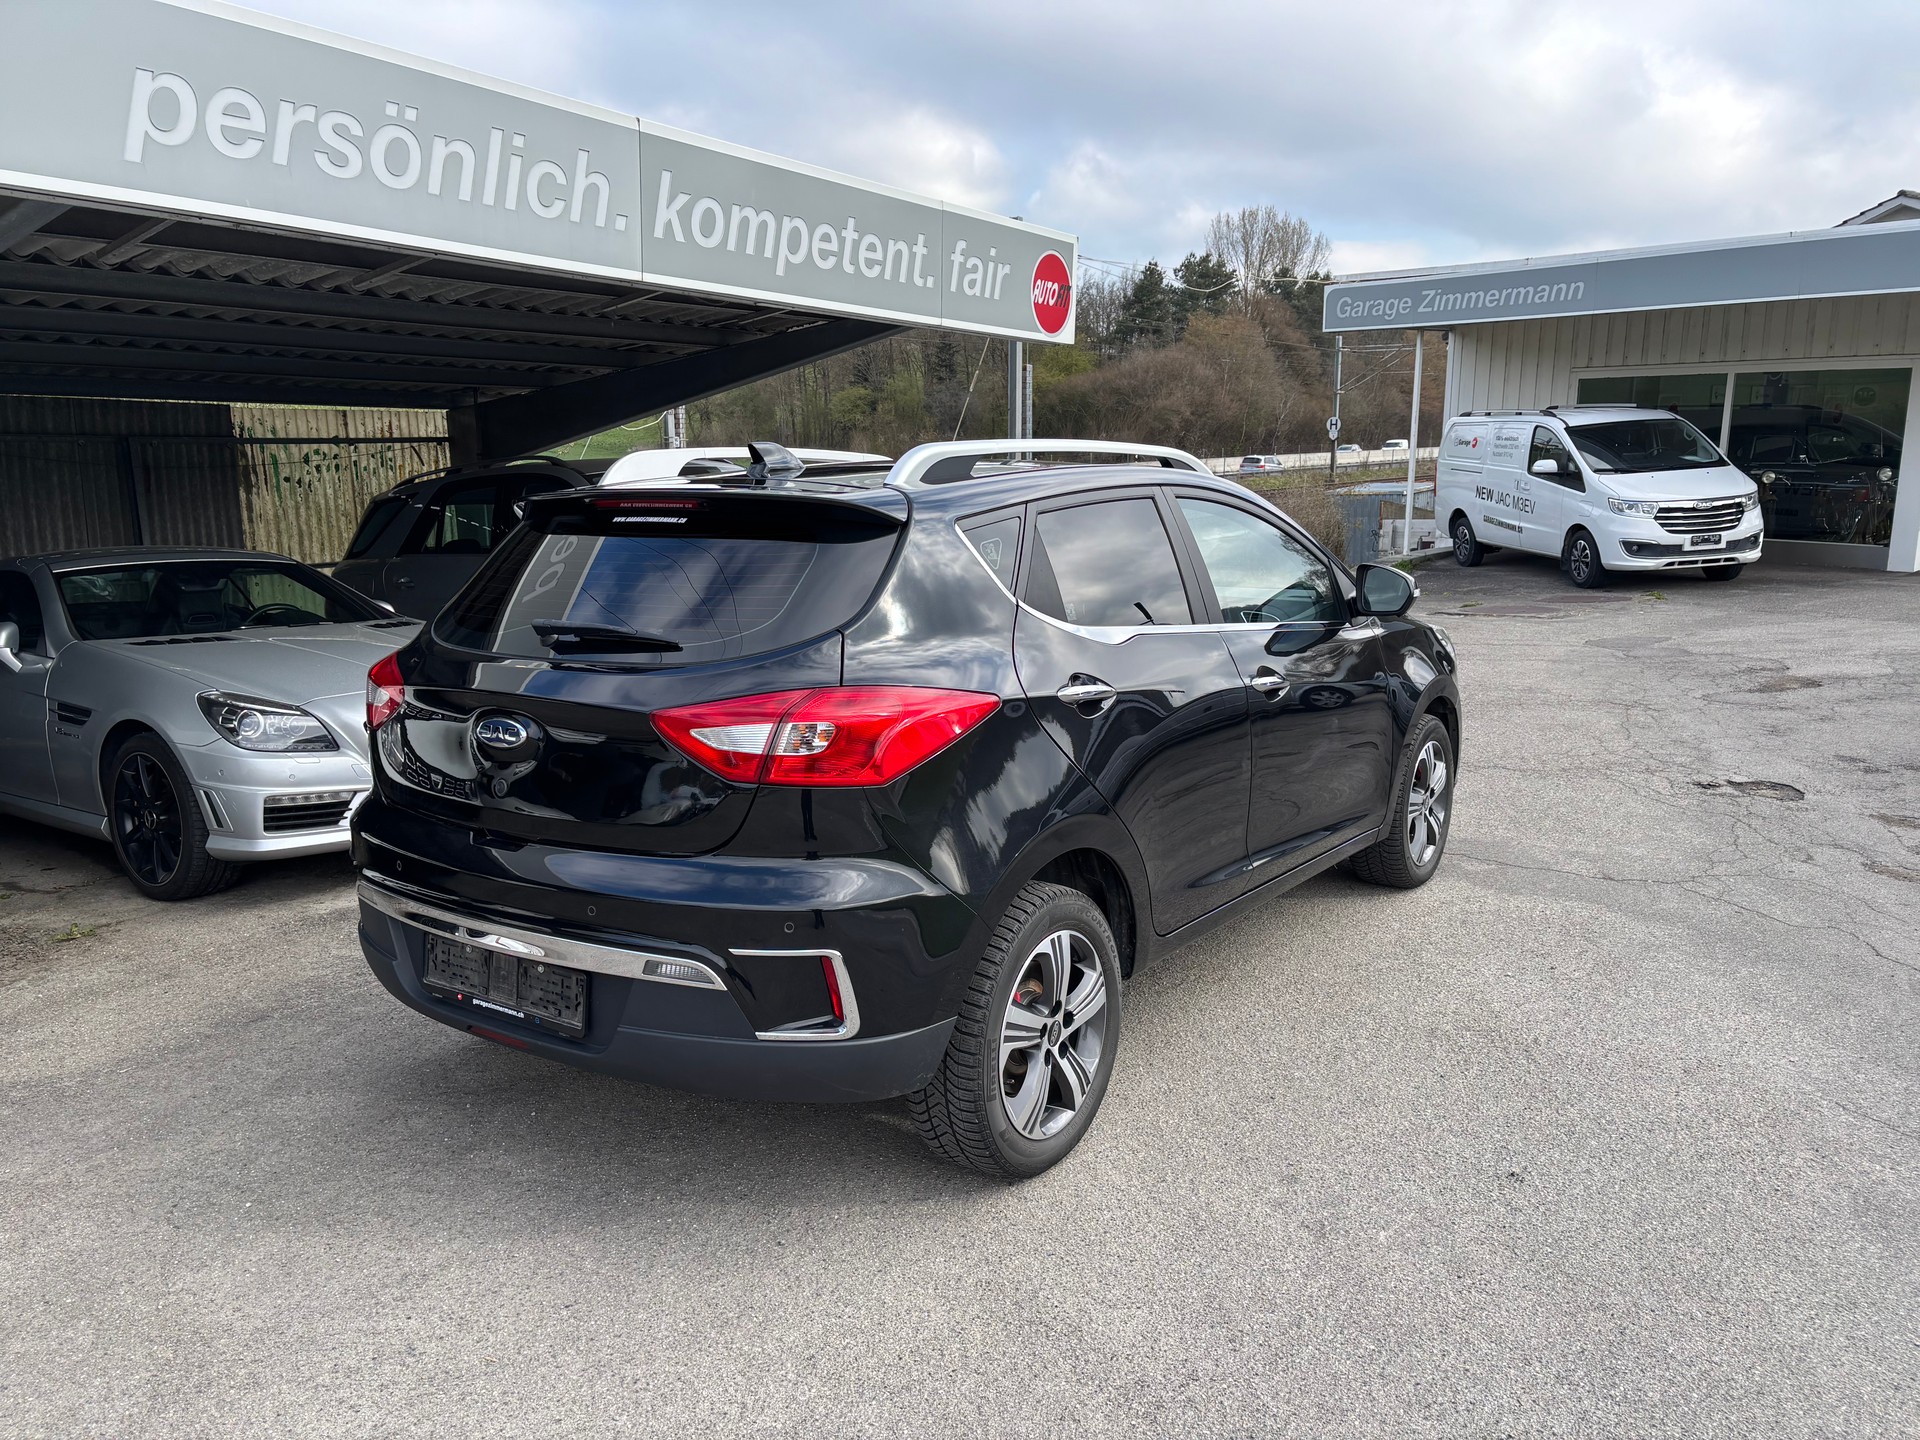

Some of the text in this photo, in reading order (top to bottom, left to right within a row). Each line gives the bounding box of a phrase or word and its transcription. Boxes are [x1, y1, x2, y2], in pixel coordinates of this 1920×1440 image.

[122, 66, 1011, 300] persönlich. kompetent. fair
[1336, 281, 1585, 320] Garage Zimmermann
[1330, 418, 1338, 430] H
[1475, 485, 1536, 514] NEW JAC M3EV
[480, 724, 517, 741] JAC
